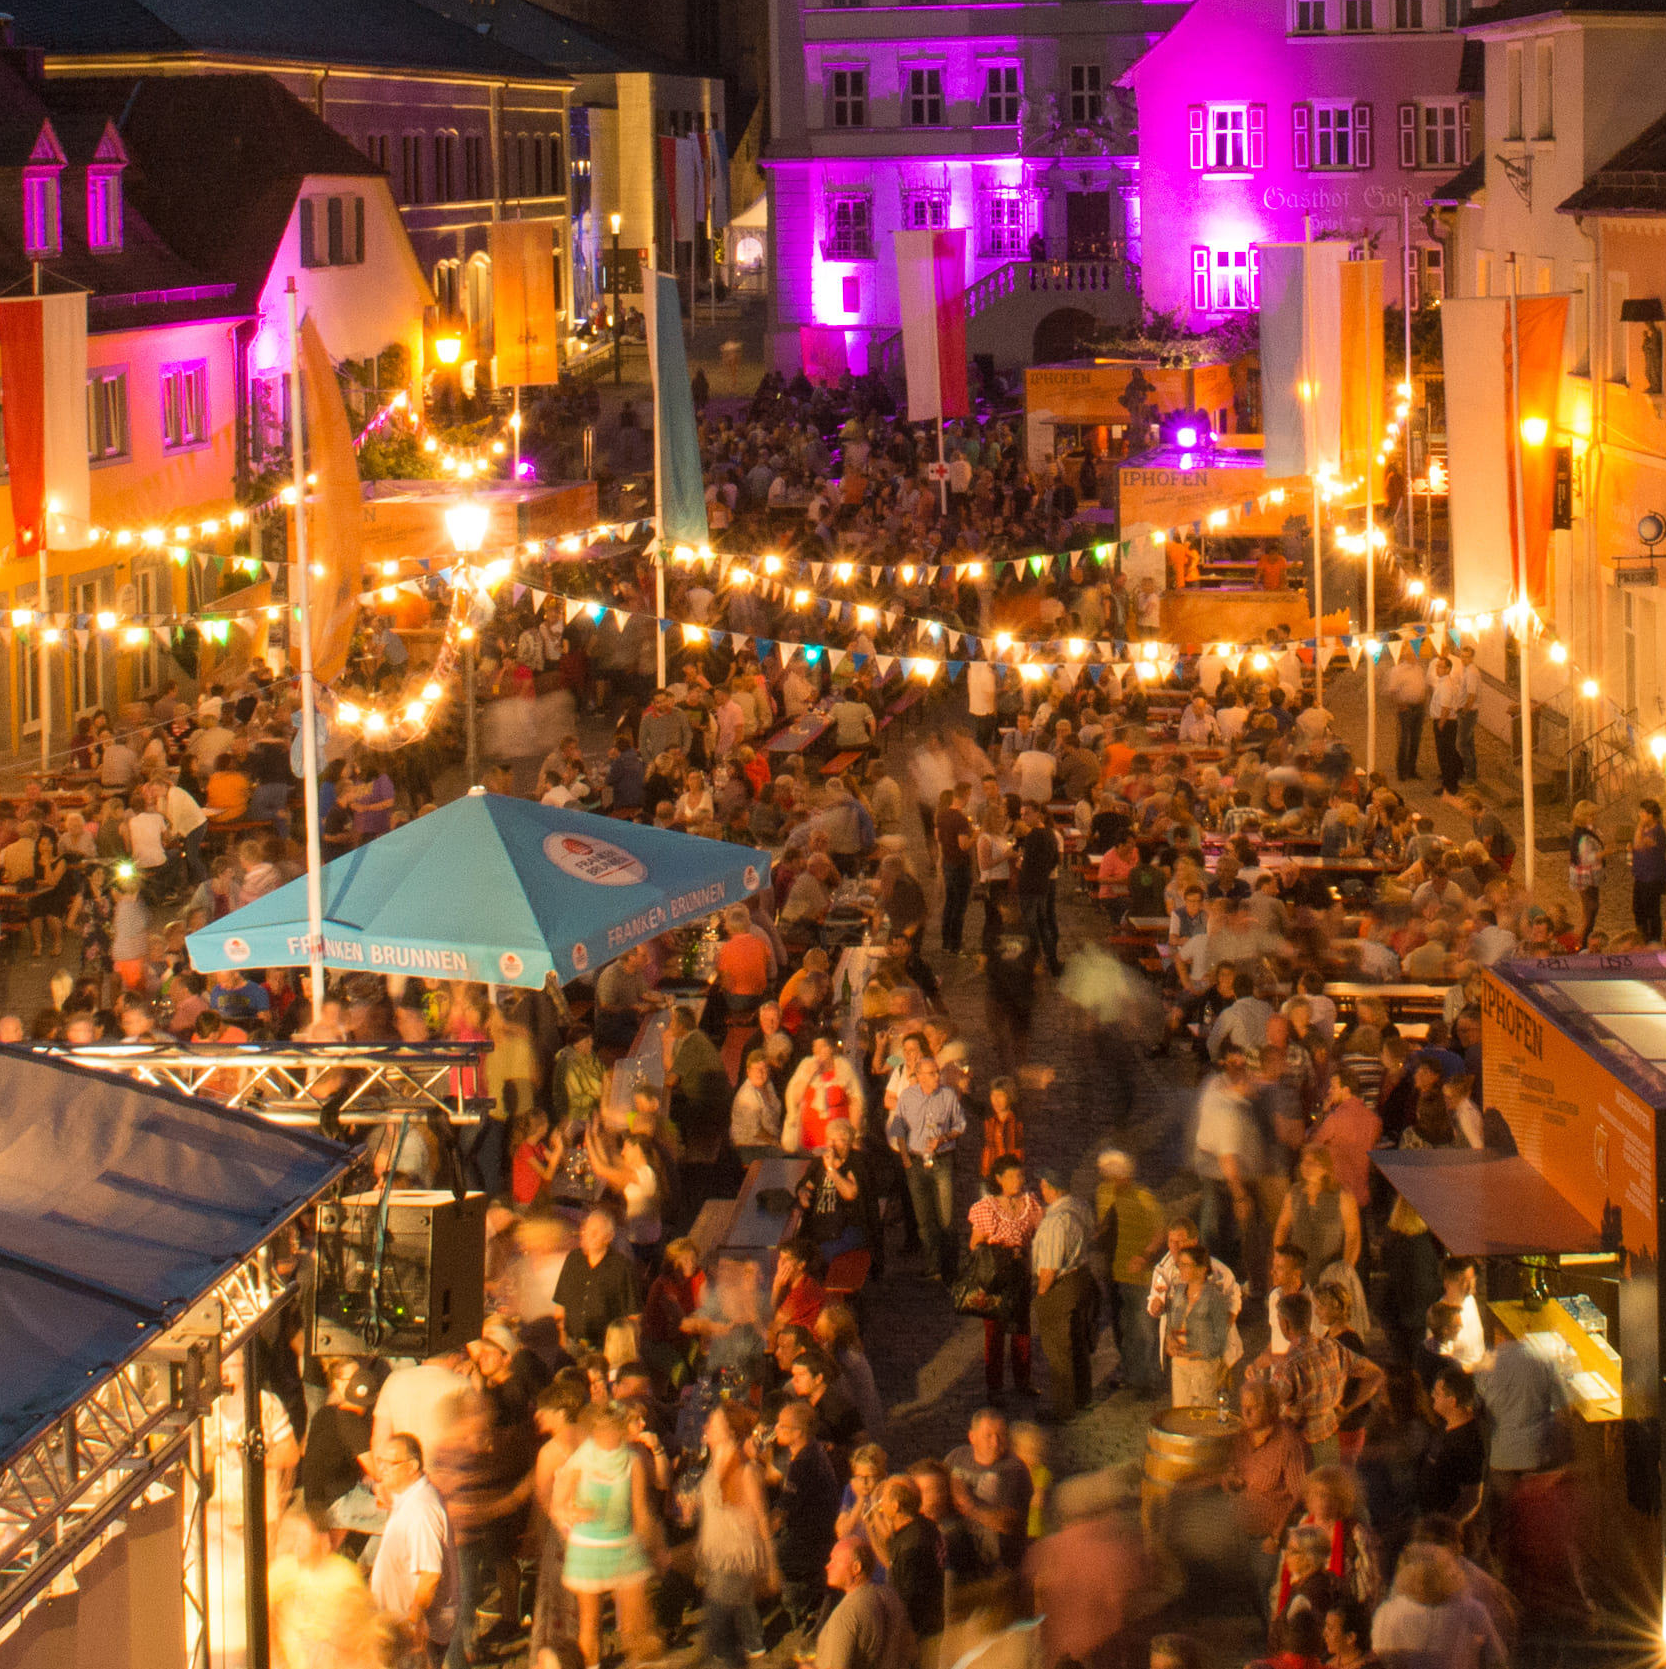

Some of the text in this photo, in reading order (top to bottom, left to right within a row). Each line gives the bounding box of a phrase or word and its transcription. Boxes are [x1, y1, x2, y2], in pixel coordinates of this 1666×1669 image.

[1263, 185, 1351, 213] Gasthof
[1030, 372, 1091, 385] IPHOFEN
[1123, 470, 1208, 487] IPHOFEN
[607, 881, 726, 949] FRANKEN BRUNNEN
[287, 936, 364, 962] FRNKEN
[370, 944, 469, 972] BRUNNEN
[1483, 978, 1544, 1061] IPHOFEN
